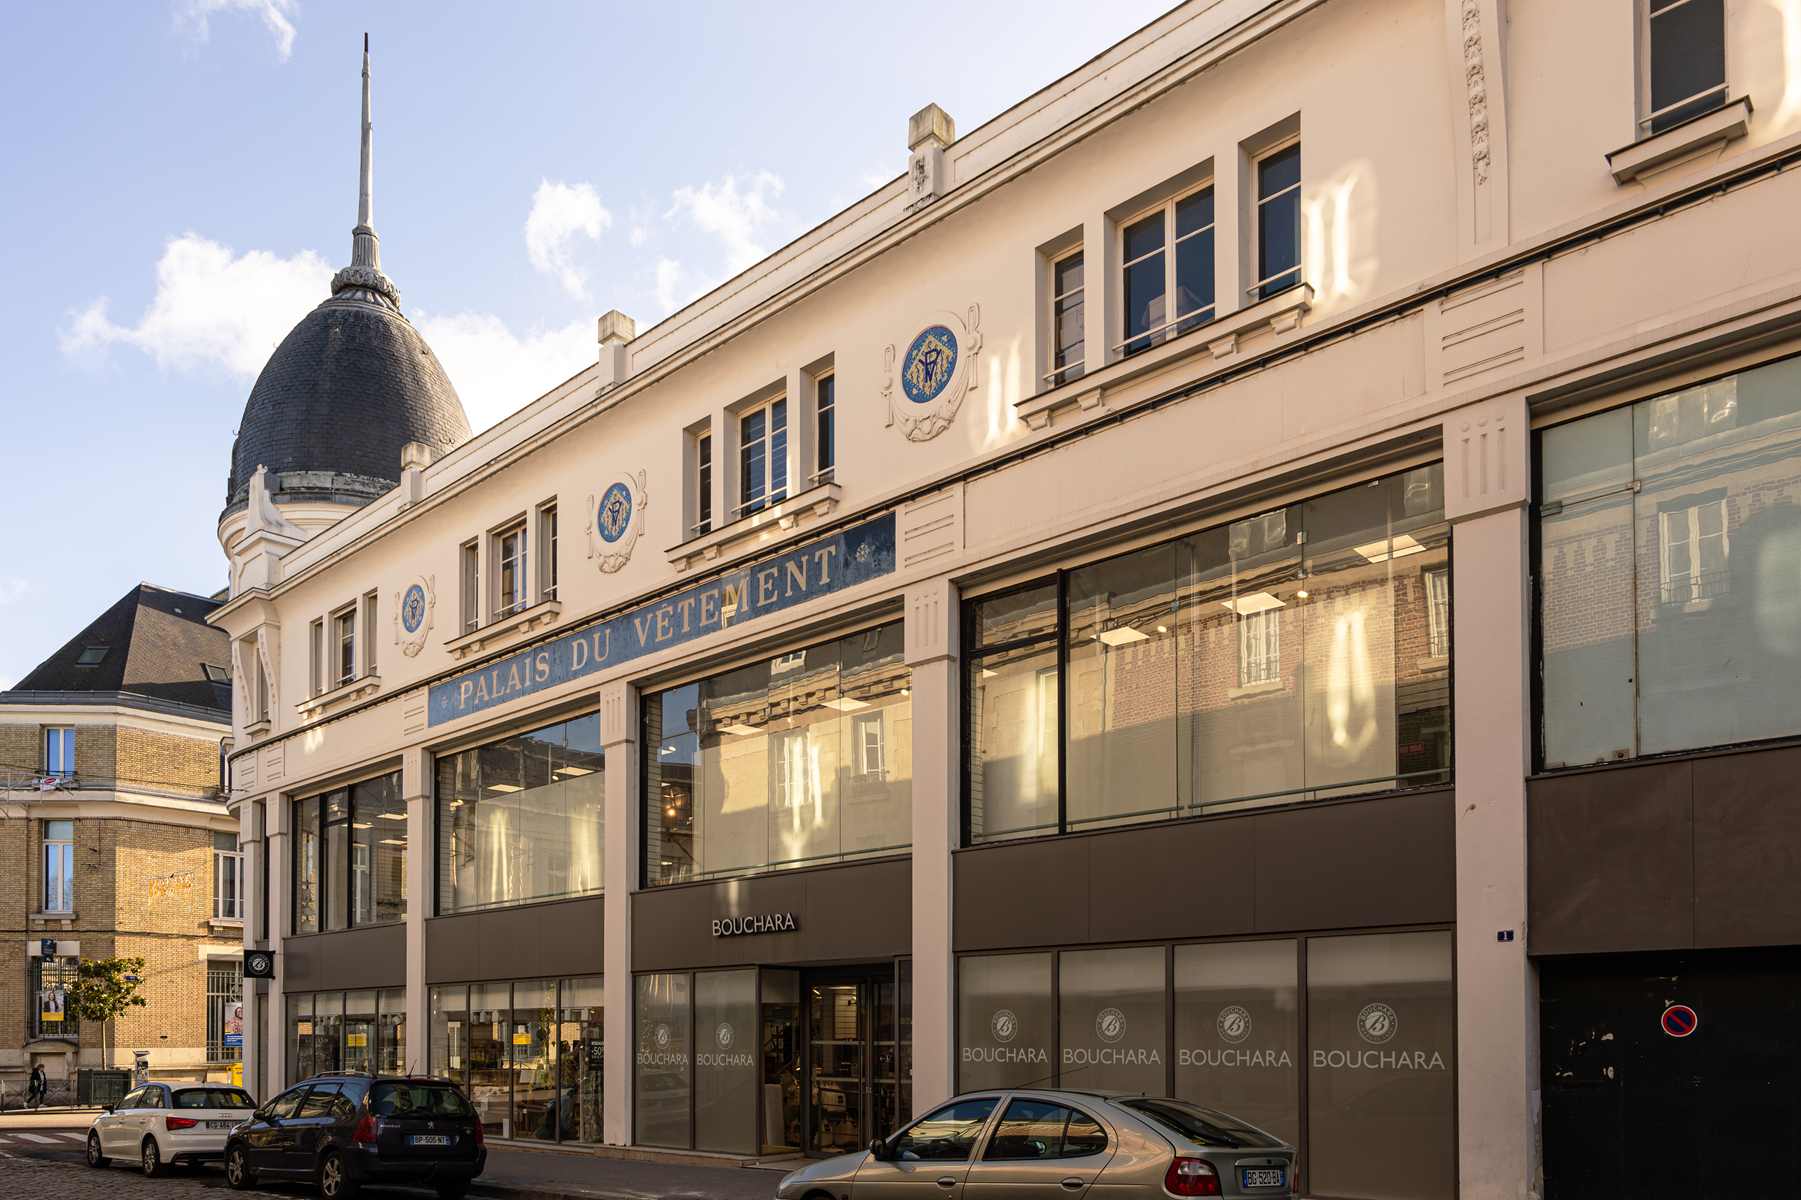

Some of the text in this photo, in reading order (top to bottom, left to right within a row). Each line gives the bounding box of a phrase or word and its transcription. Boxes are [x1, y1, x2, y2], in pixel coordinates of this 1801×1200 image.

[458, 544, 837, 709] PALAIS DU VÊTEMENT
[712, 912, 796, 937] BOUCHARA
[636, 1052, 689, 1065] BOUCHARA
[696, 1053, 754, 1067] BOUCHARA
[962, 1047, 1048, 1064] BOUCHARA
[1063, 1048, 1161, 1065] BOUCHARA
[1179, 1048, 1293, 1068] BOUCHARA
[1312, 1050, 1446, 1070] BOUCHARA
